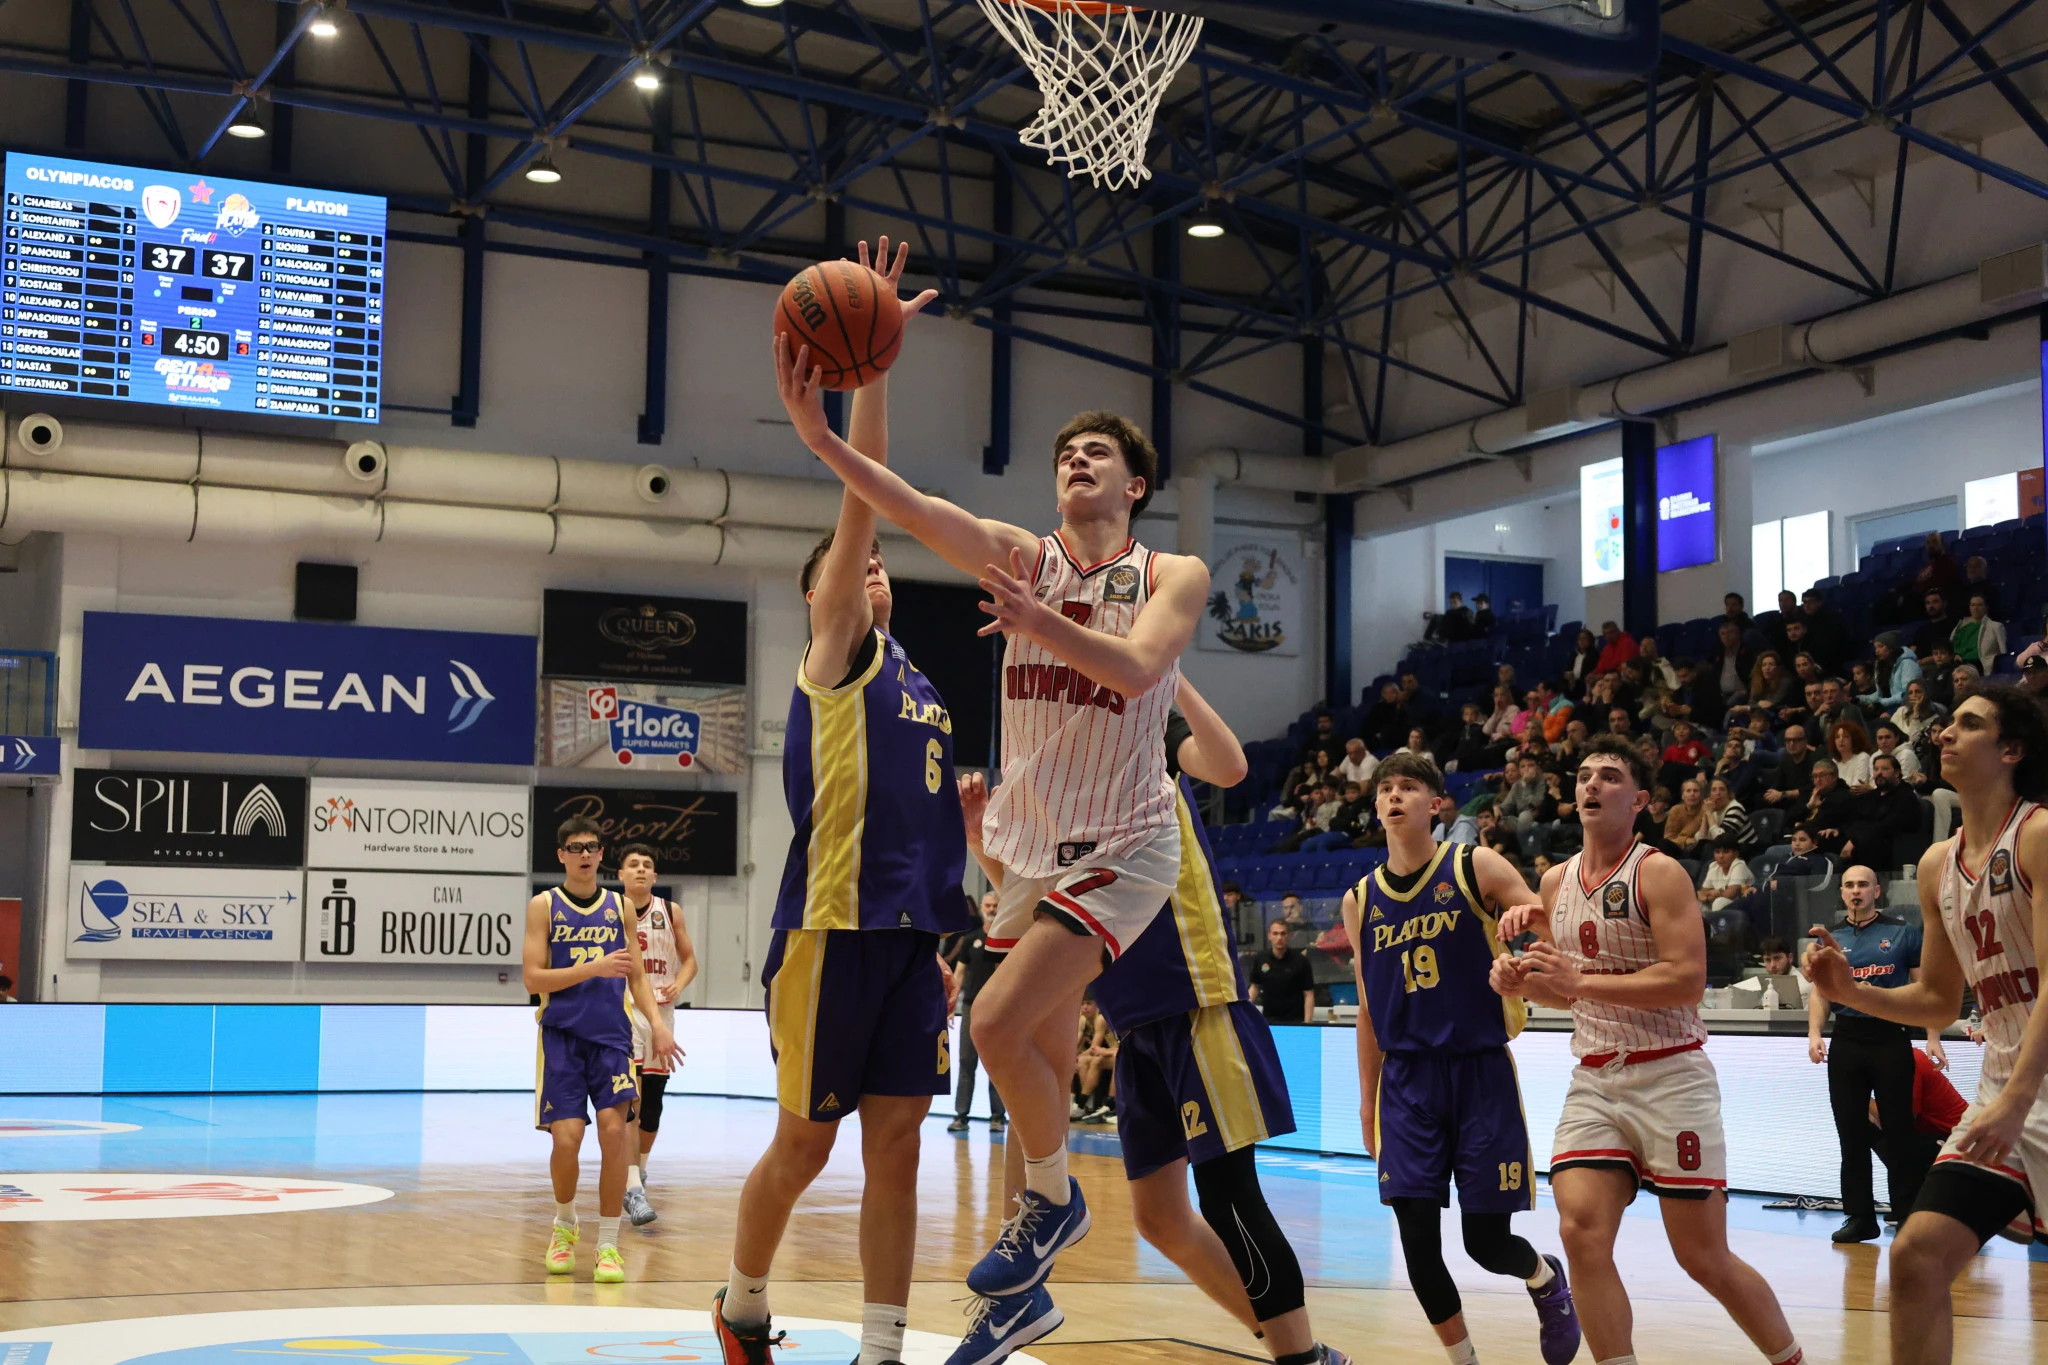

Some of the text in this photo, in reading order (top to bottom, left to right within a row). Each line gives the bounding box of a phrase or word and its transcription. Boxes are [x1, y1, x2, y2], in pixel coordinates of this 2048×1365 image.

[26, 168, 135, 191] OLYMPIACOS
[11, 196, 18, 204] 4
[286, 198, 348, 217] PLATON
[22, 214, 80, 228] KONSTANTIN
[127, 226, 133, 234] 2
[277, 227, 316, 240] KOUTRAS
[10, 227, 75, 244] 6 ALEXAND A
[9, 245, 132, 266] 7 SPANOULIS 7
[276, 241, 310, 254] KIOUSIS
[152, 247, 186, 270] 37
[211, 254, 246, 277] 37
[264, 257, 270, 265] 6
[20, 263, 79, 277] CHRISTODOU
[123, 274, 134, 283] 10
[262, 271, 330, 288] 11 XYNOGALAS
[8, 277, 63, 292] 9 KOSTAKIS
[261, 288, 271, 298] 12
[5, 293, 80, 310] 10 ALEXAND AG
[261, 303, 271, 313] 19
[274, 305, 315, 319] MPARLOS
[4, 309, 15, 319] 11
[178, 305, 218, 318] PERIOD
[2, 326, 14, 335] 12
[17, 328, 49, 340] PEPPES
[191, 318, 201, 329] 2
[259, 319, 271, 329] 22
[144, 334, 154, 345] 3
[174, 334, 220, 356] 4:50
[272, 337, 331, 351] PANAGIOTOP
[239, 344, 248, 355] 3
[1, 359, 131, 380] 14 NASTAS 10
[15, 377, 69, 391] EYSTATHIAD
[617, 618, 679, 635] QUEEN
[1223, 621, 1282, 641] SAKIS
[125, 662, 427, 715] AEGEAN
[616, 704, 694, 739] flora
[898, 690, 952, 735] PLATO
[622, 739, 690, 750] SUPER MARKETS
[926, 738, 943, 794] 6
[90, 776, 287, 837] SPILIA
[154, 850, 224, 858] MYKONOS
[364, 843, 475, 855] Hardware Store & More
[434, 886, 462, 904] CAVA
[132, 902, 275, 925] SEA & SKY
[135, 929, 269, 940] TRAVEL AGENCY
[381, 911, 512, 956] BROUZOS
[552, 925, 619, 944] PLATON
[1373, 910, 1462, 953] PLATON
[1579, 921, 1600, 960] 8
[1964, 909, 2005, 962] 12
[570, 946, 605, 968] 22
[1401, 945, 1440, 994] 19
[612, 1073, 635, 1094] 22
[1677, 1131, 1702, 1171] 8
[1499, 1162, 1522, 1192] 19
